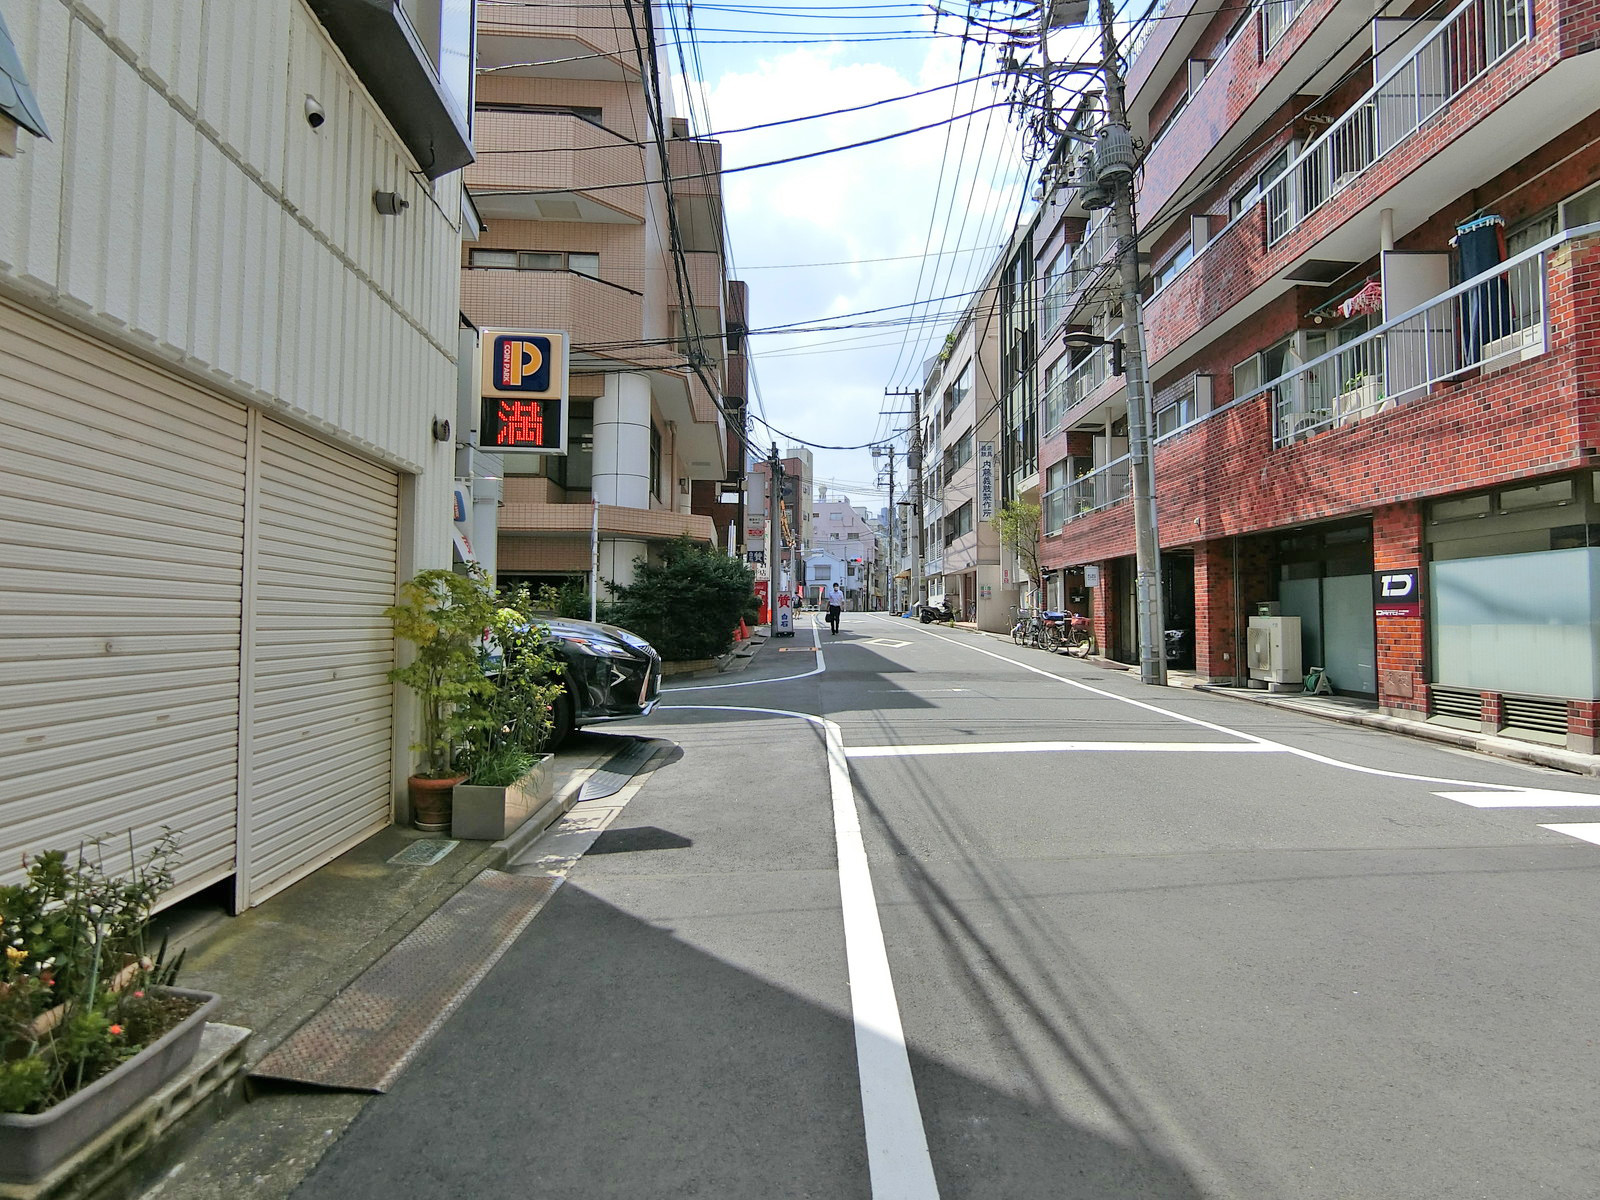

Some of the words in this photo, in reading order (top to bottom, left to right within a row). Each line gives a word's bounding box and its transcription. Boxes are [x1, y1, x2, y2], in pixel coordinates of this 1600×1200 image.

[503, 345, 511, 363] COIN
[503, 363, 511, 382] PARK
[497, 400, 543, 446] 満
[777, 594, 791, 609] 質
[780, 613, 789, 628] 白石
